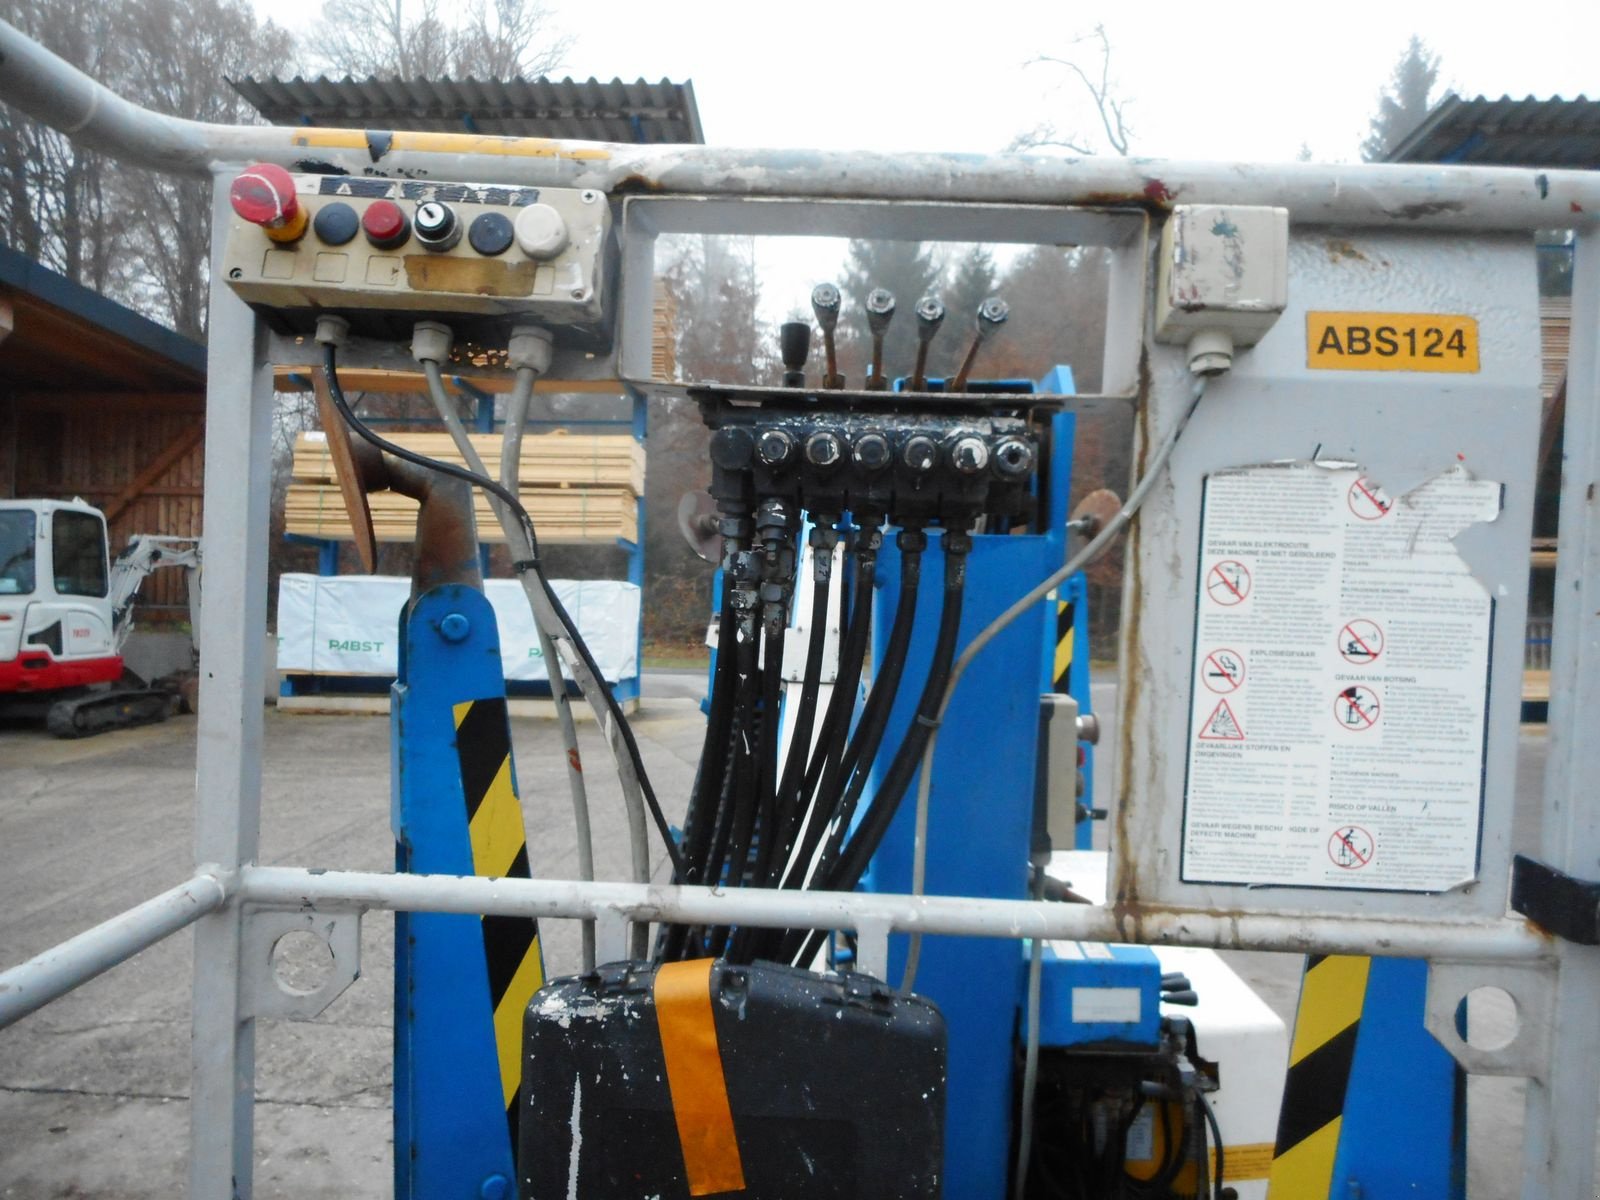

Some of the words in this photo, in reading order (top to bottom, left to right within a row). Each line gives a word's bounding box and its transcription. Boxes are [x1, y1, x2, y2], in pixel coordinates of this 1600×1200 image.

[1317, 325, 1467, 358] ABS124
[1206, 548, 1226, 556] DEZE
[1227, 548, 1260, 557] MACHINE
[1270, 550, 1287, 558] NIET
[328, 638, 385, 652] PABST
[1356, 803, 1368, 811] OP
